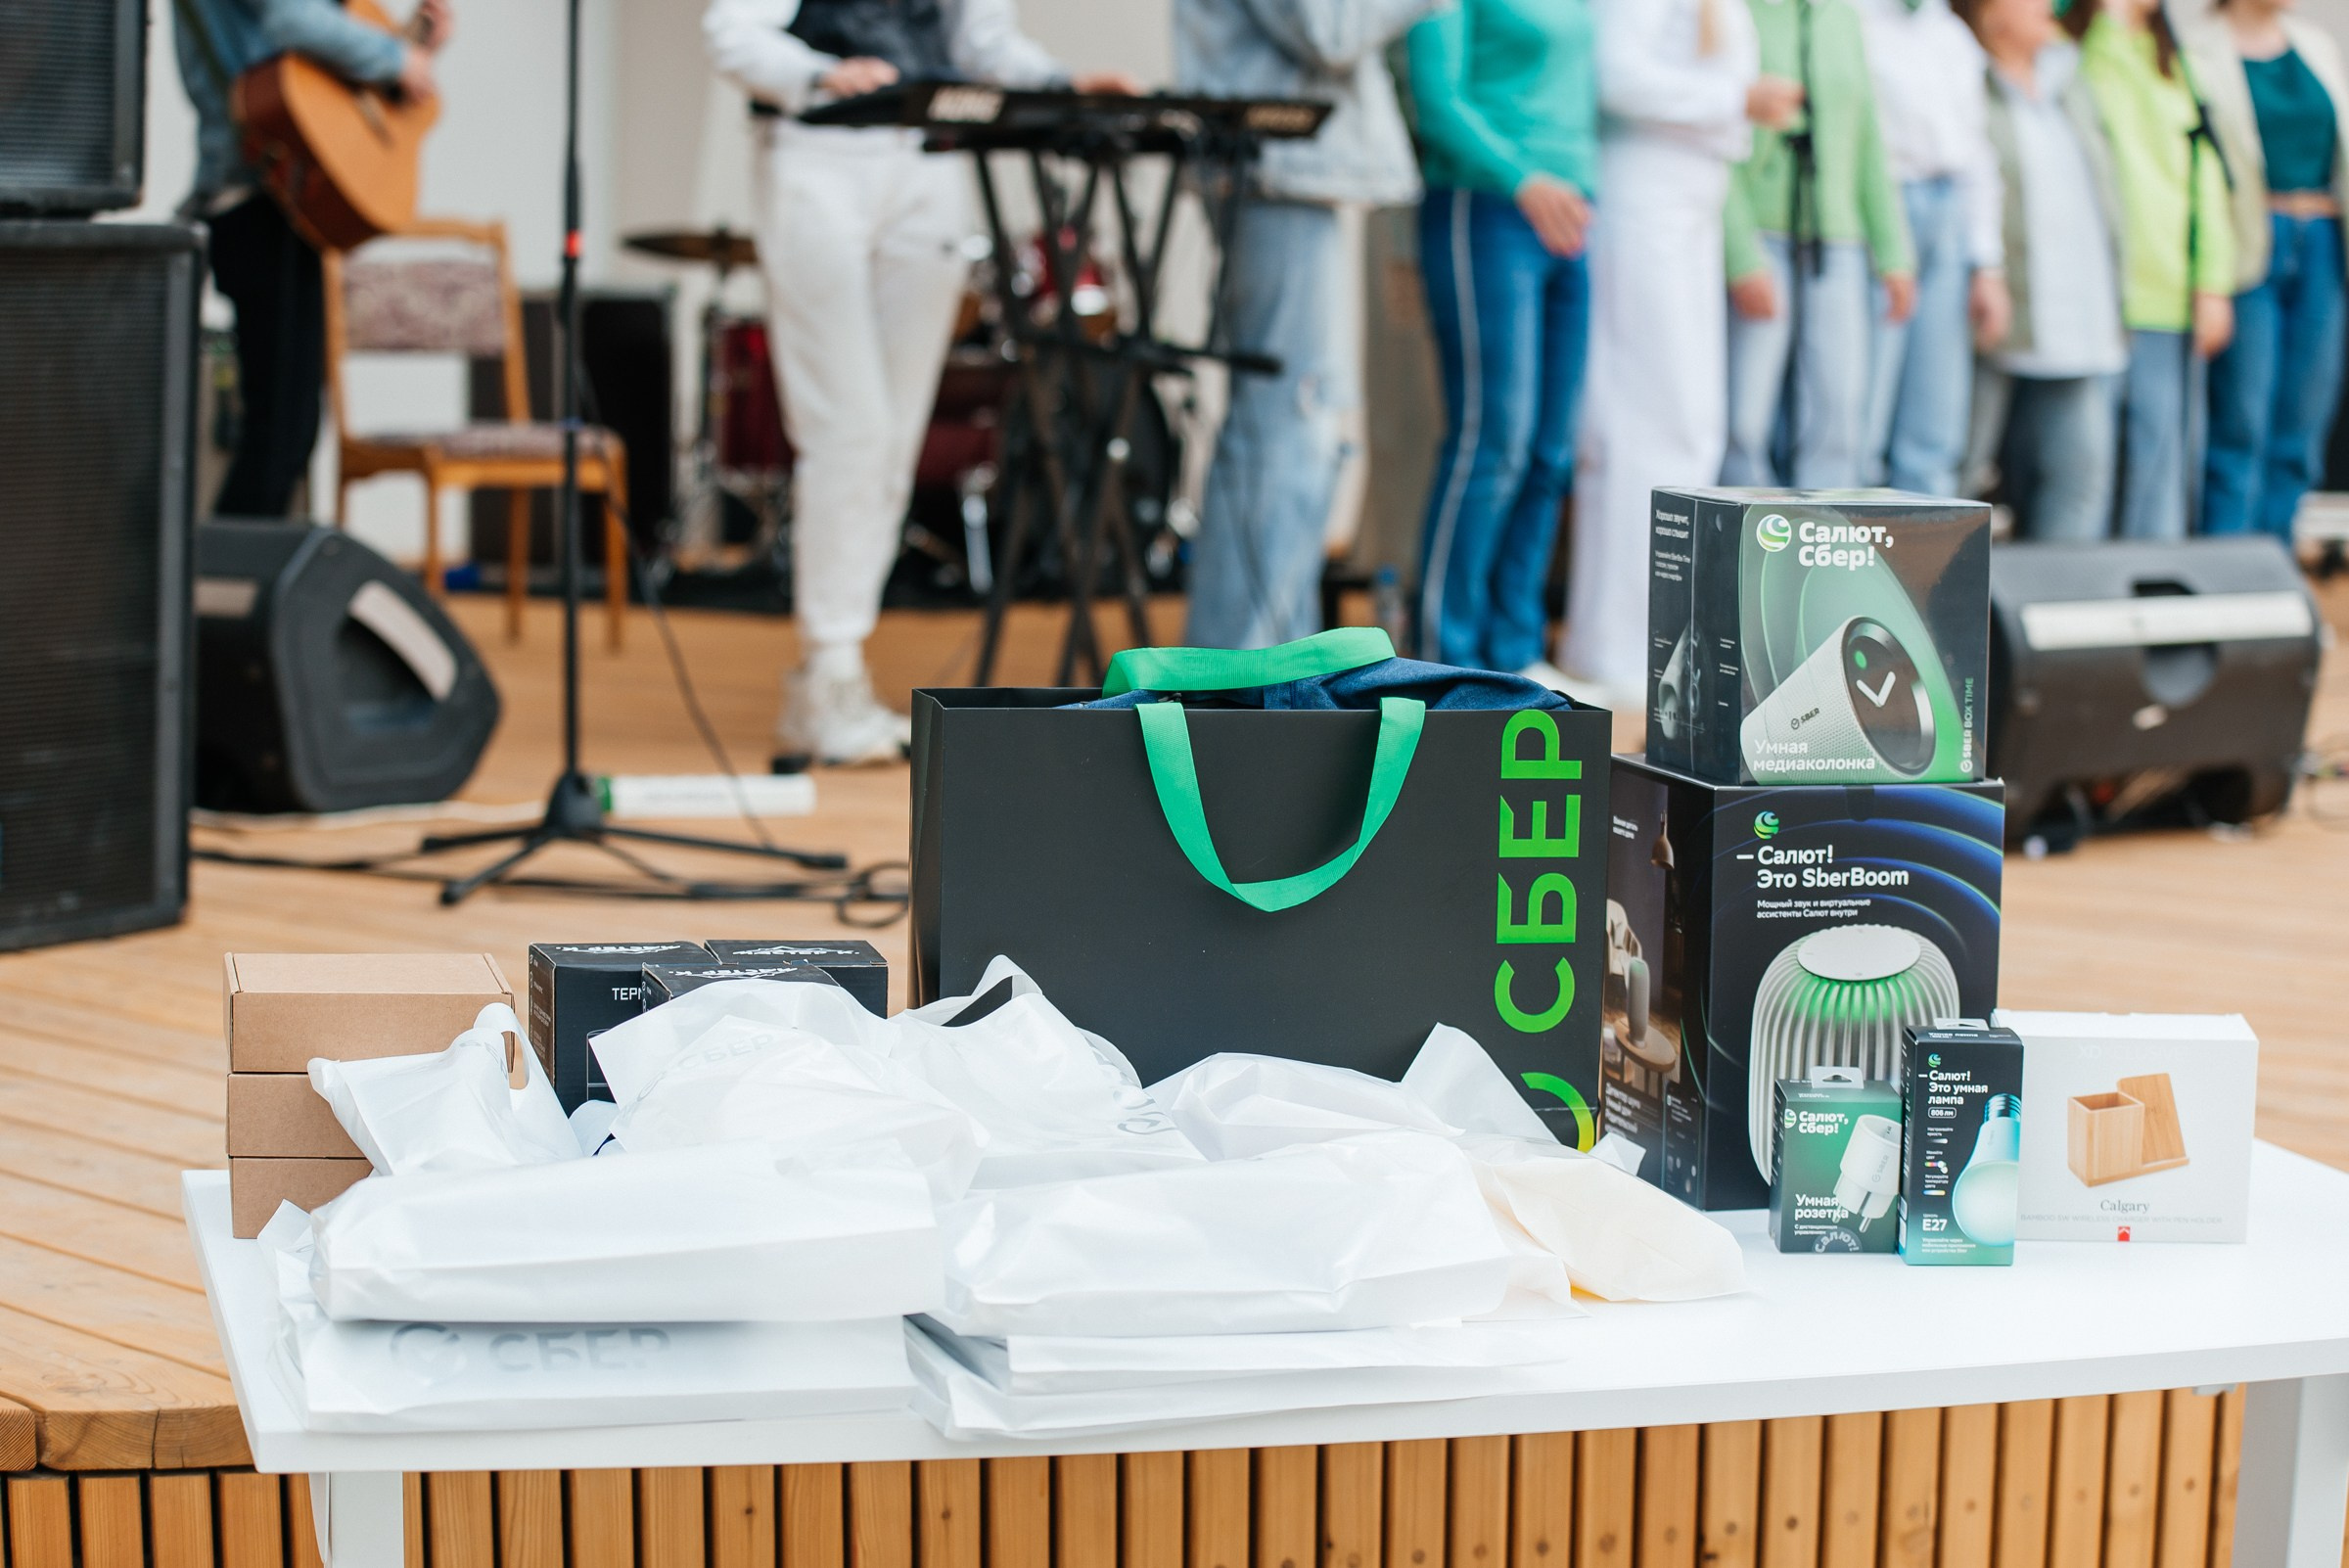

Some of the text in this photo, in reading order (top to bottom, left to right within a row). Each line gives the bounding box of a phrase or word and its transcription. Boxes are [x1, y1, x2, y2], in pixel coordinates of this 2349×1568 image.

[1799, 521, 1894, 548] Салют,
[1798, 543, 1875, 571] Сбер!
[1800, 707, 1819, 723] SBER
[1962, 677, 1974, 759] SBER BOX TIME
[1754, 739, 1809, 754] Умная
[1753, 758, 1875, 772] медиаколонка
[1757, 844, 1833, 865] Салют!
[1495, 710, 1582, 1034] СБЕР
[1757, 866, 1909, 889] Это SberBoom
[1757, 899, 1792, 908] Мощный
[1793, 899, 1812, 909] звук
[1819, 899, 1870, 908] виртуальные
[1757, 908, 1858, 919] ассистенты Салют внутри
[1929, 1070, 1970, 1082] Салют!
[1929, 1082, 1988, 1095] Это умная
[1928, 1095, 1964, 1105] лампа
[1798, 1110, 1849, 1125] Салют,
[1798, 1122, 1839, 1135] Сбер!
[1795, 1193, 1839, 1207] Умная
[2100, 1199, 2150, 1213] Calgary
[1794, 1208, 1849, 1222] розетка
[2020, 1214, 2055, 1222] BAMBOO
[1922, 1219, 1948, 1231] E27
[491, 1327, 670, 1372] СБЕР
